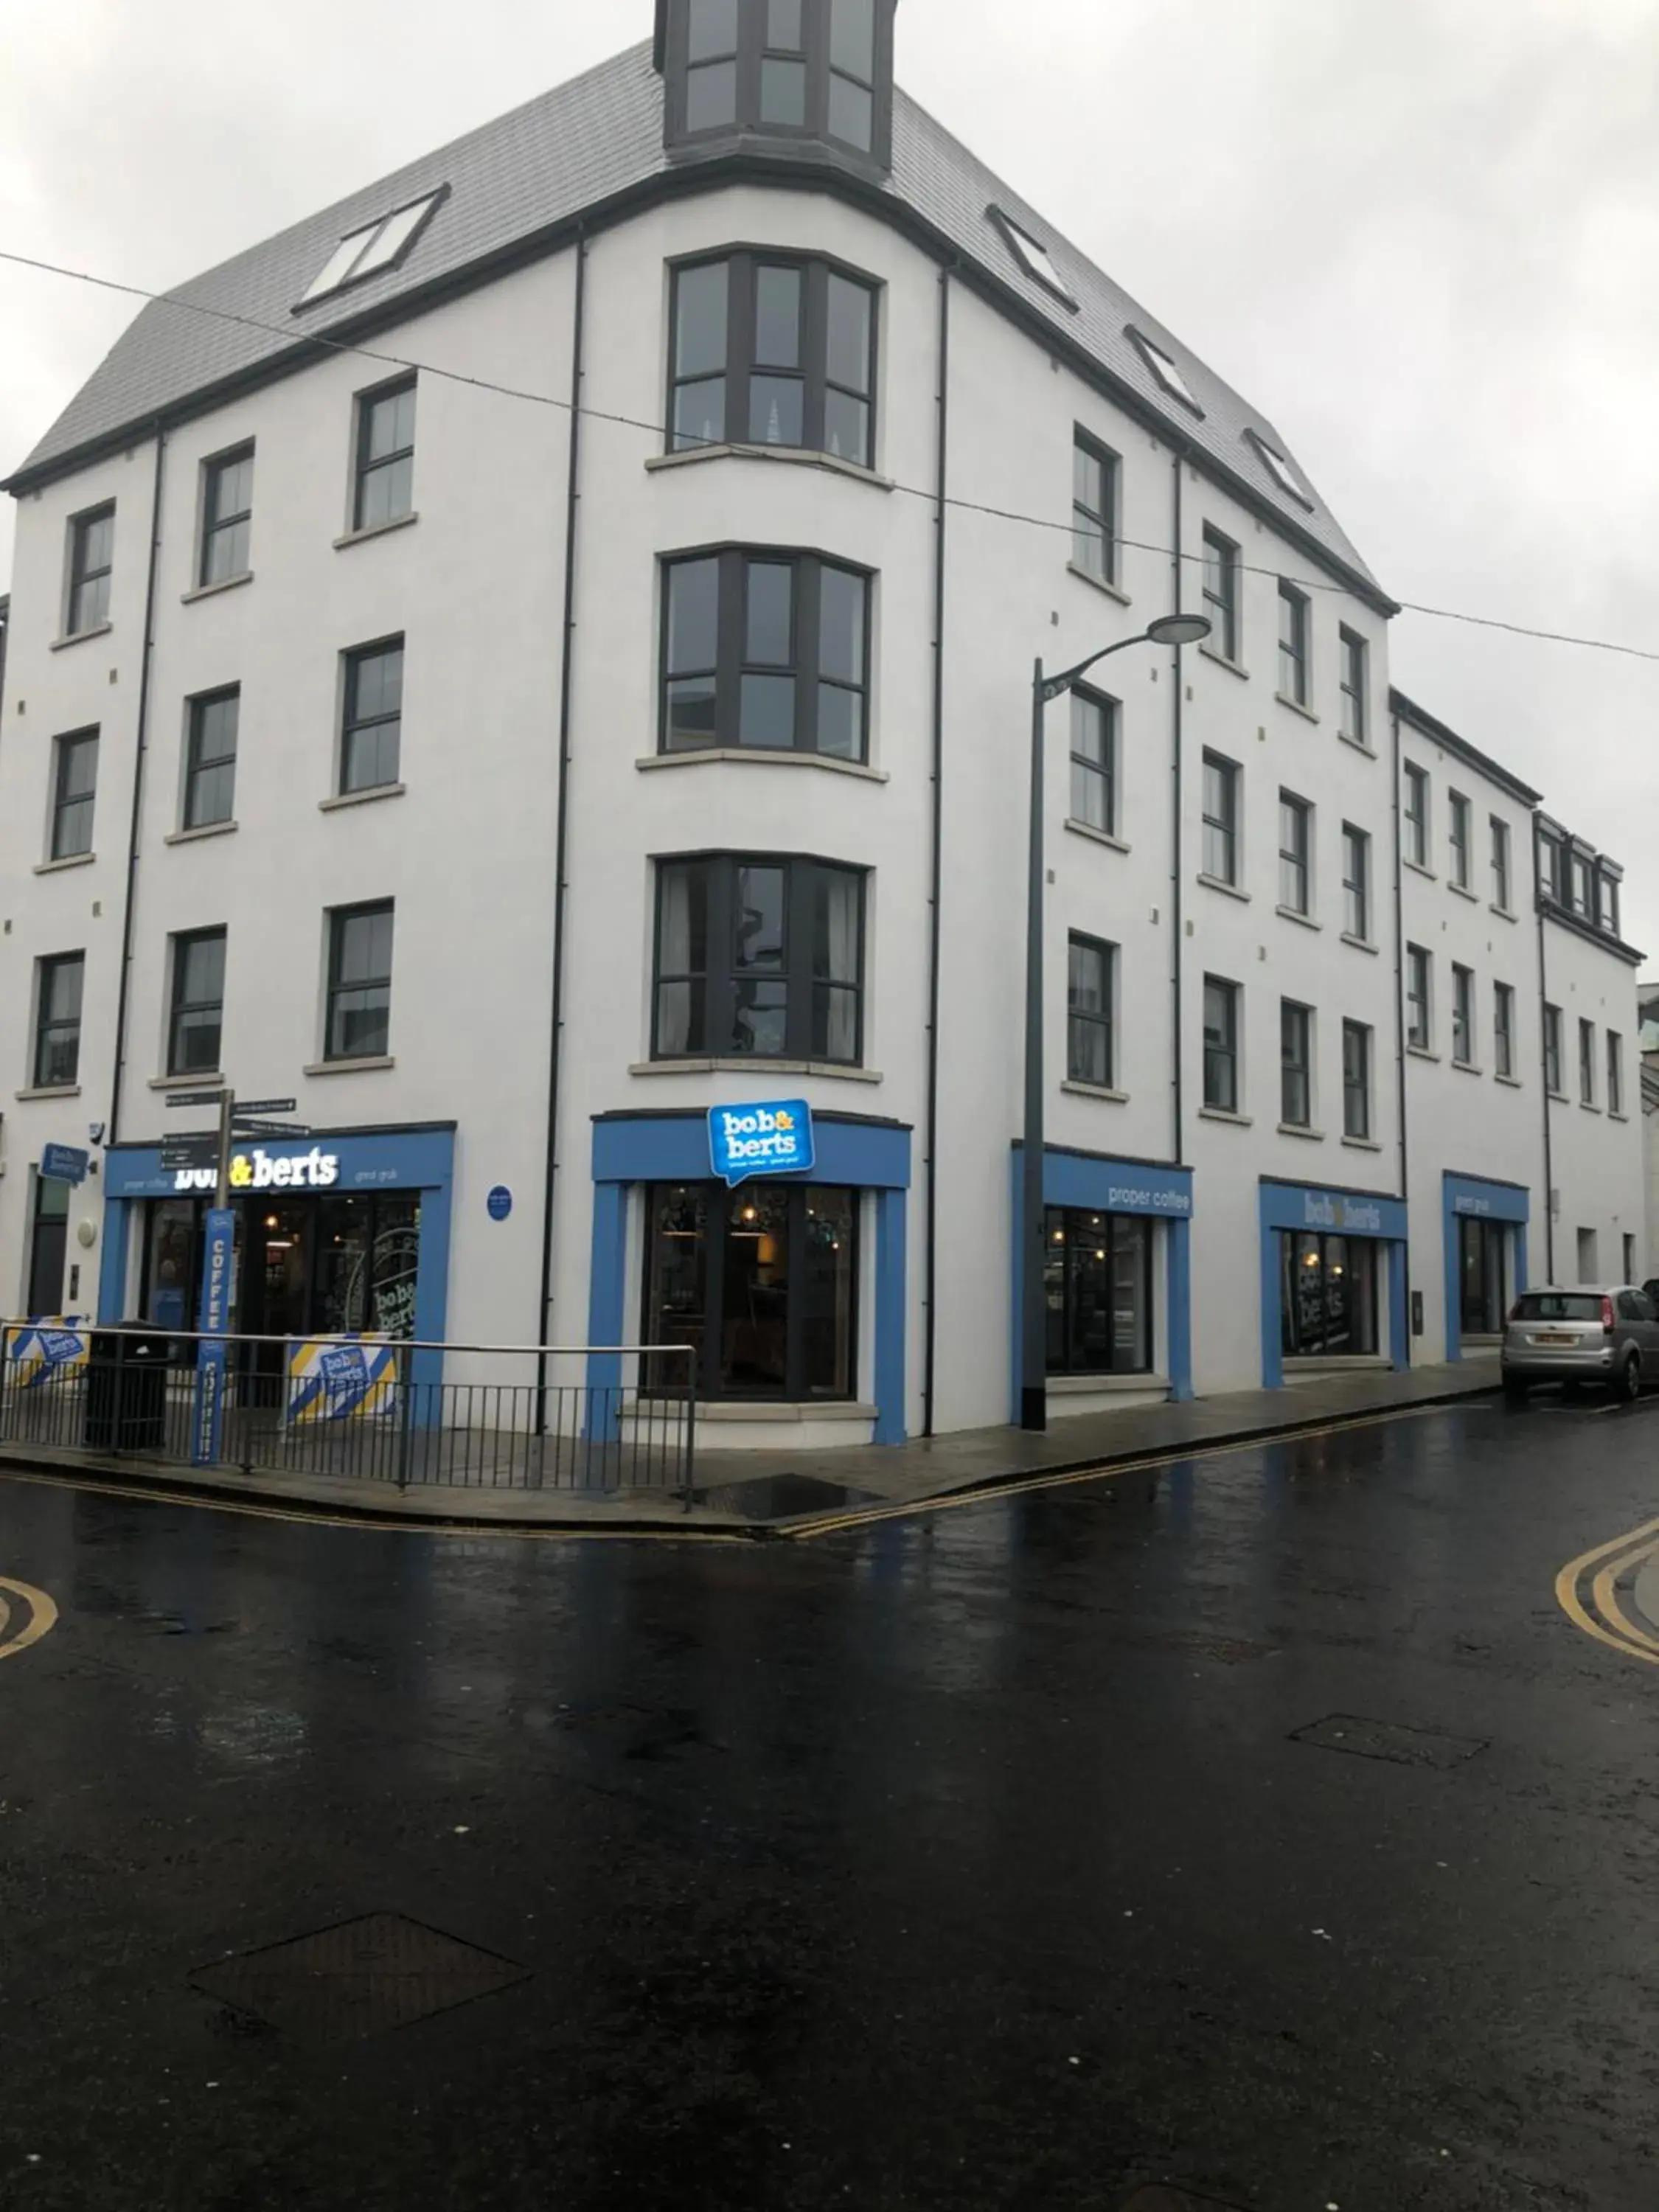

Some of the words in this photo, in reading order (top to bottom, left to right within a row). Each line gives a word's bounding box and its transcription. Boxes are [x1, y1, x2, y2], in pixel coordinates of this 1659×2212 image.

[726, 1133, 796, 1159] berts
[1108, 1187, 1150, 1206] proper
[1153, 1189, 1190, 1209] coffee
[207, 1239, 224, 1329] COFFEE
